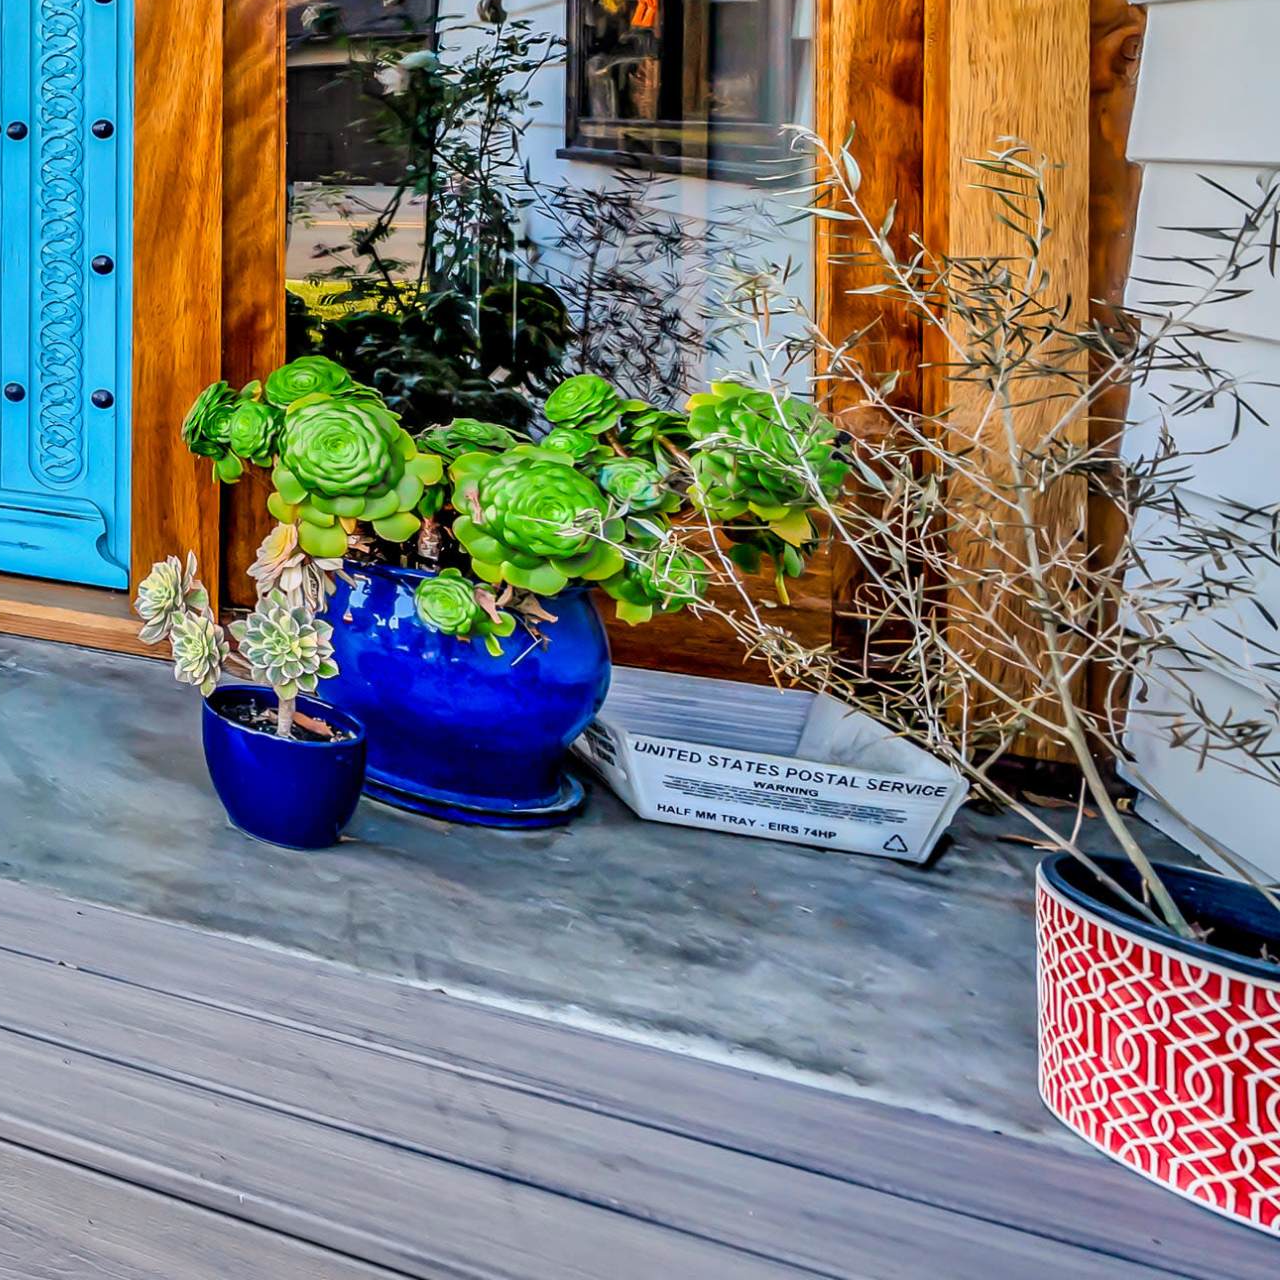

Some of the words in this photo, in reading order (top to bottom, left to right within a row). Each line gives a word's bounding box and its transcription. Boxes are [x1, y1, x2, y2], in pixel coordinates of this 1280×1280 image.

[634, 741, 702, 764] UNITED
[707, 755, 780, 777] STATES
[785, 767, 860, 789] POSTAL
[866, 778, 947, 798] SERVICE
[753, 781, 819, 798] WARNING
[657, 803, 692, 816] HALF
[695, 810, 717, 821] MM
[722, 814, 757, 827] TRAY
[768, 822, 799, 834] EIRS
[803, 827, 837, 839] 74HP
